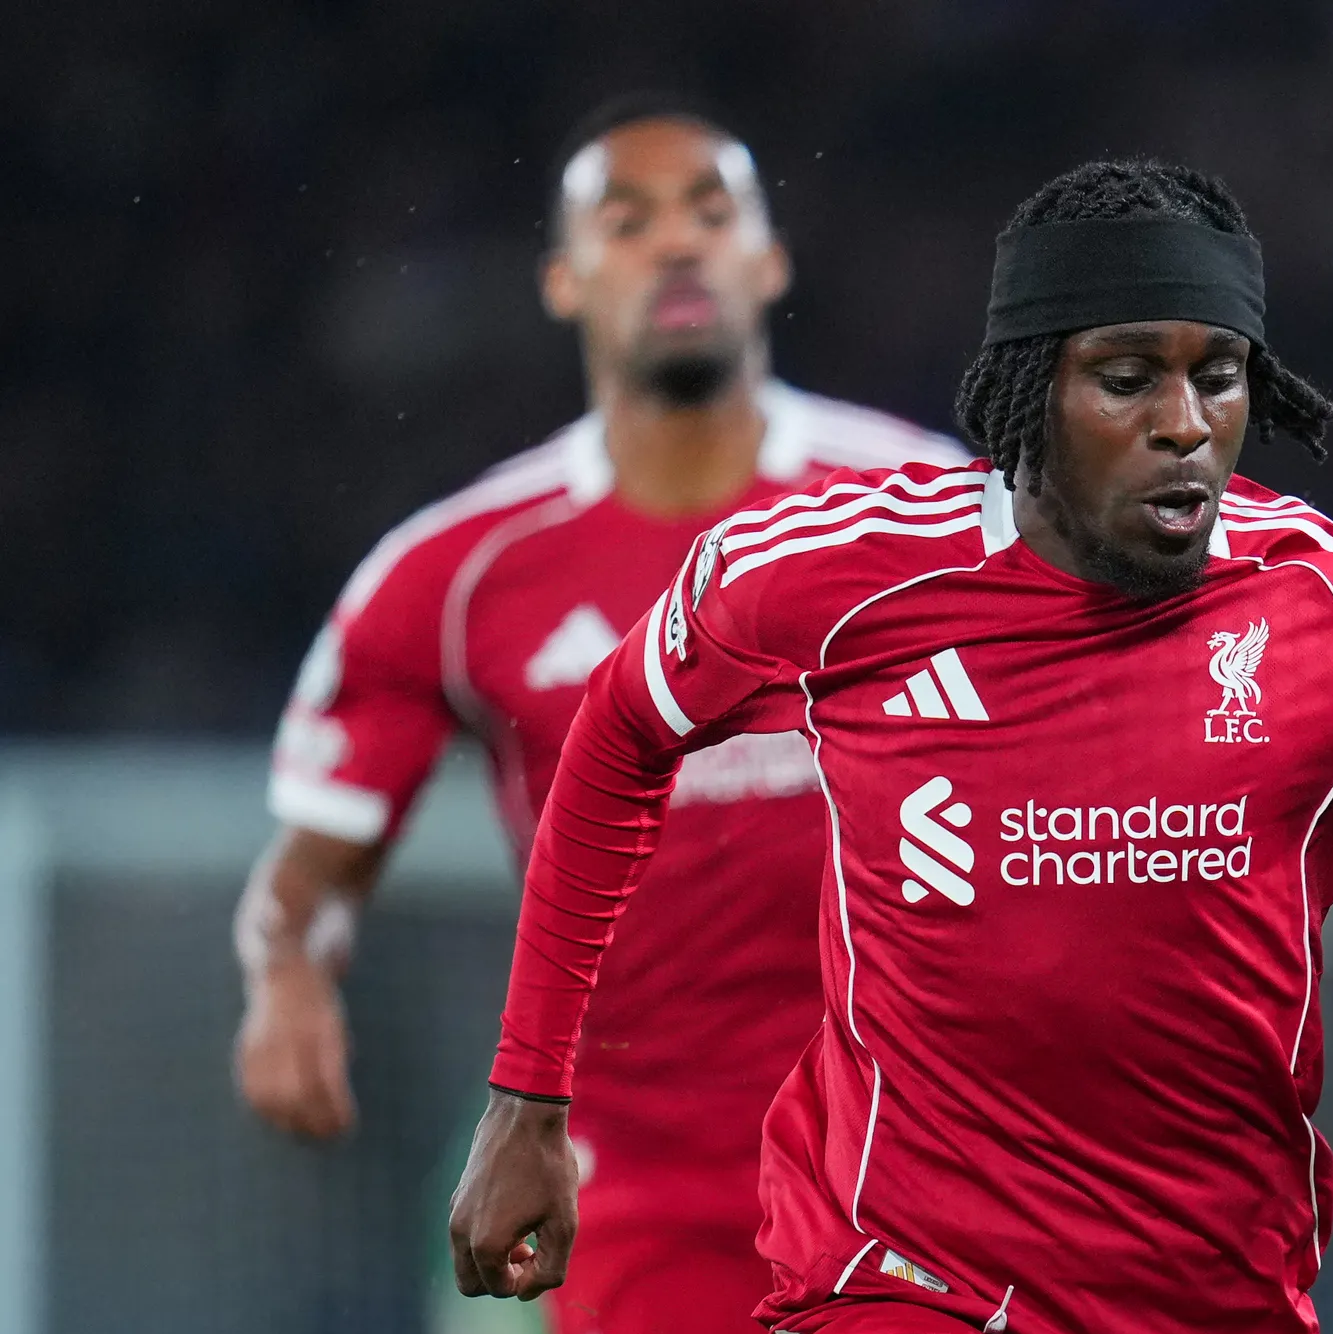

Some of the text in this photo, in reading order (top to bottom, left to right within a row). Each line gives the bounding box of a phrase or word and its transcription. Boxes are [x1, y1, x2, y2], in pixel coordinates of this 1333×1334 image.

[1203, 717, 1270, 743] L.F.C.
[1000, 795, 1248, 842] standard
[1000, 836, 1253, 886] chartered
